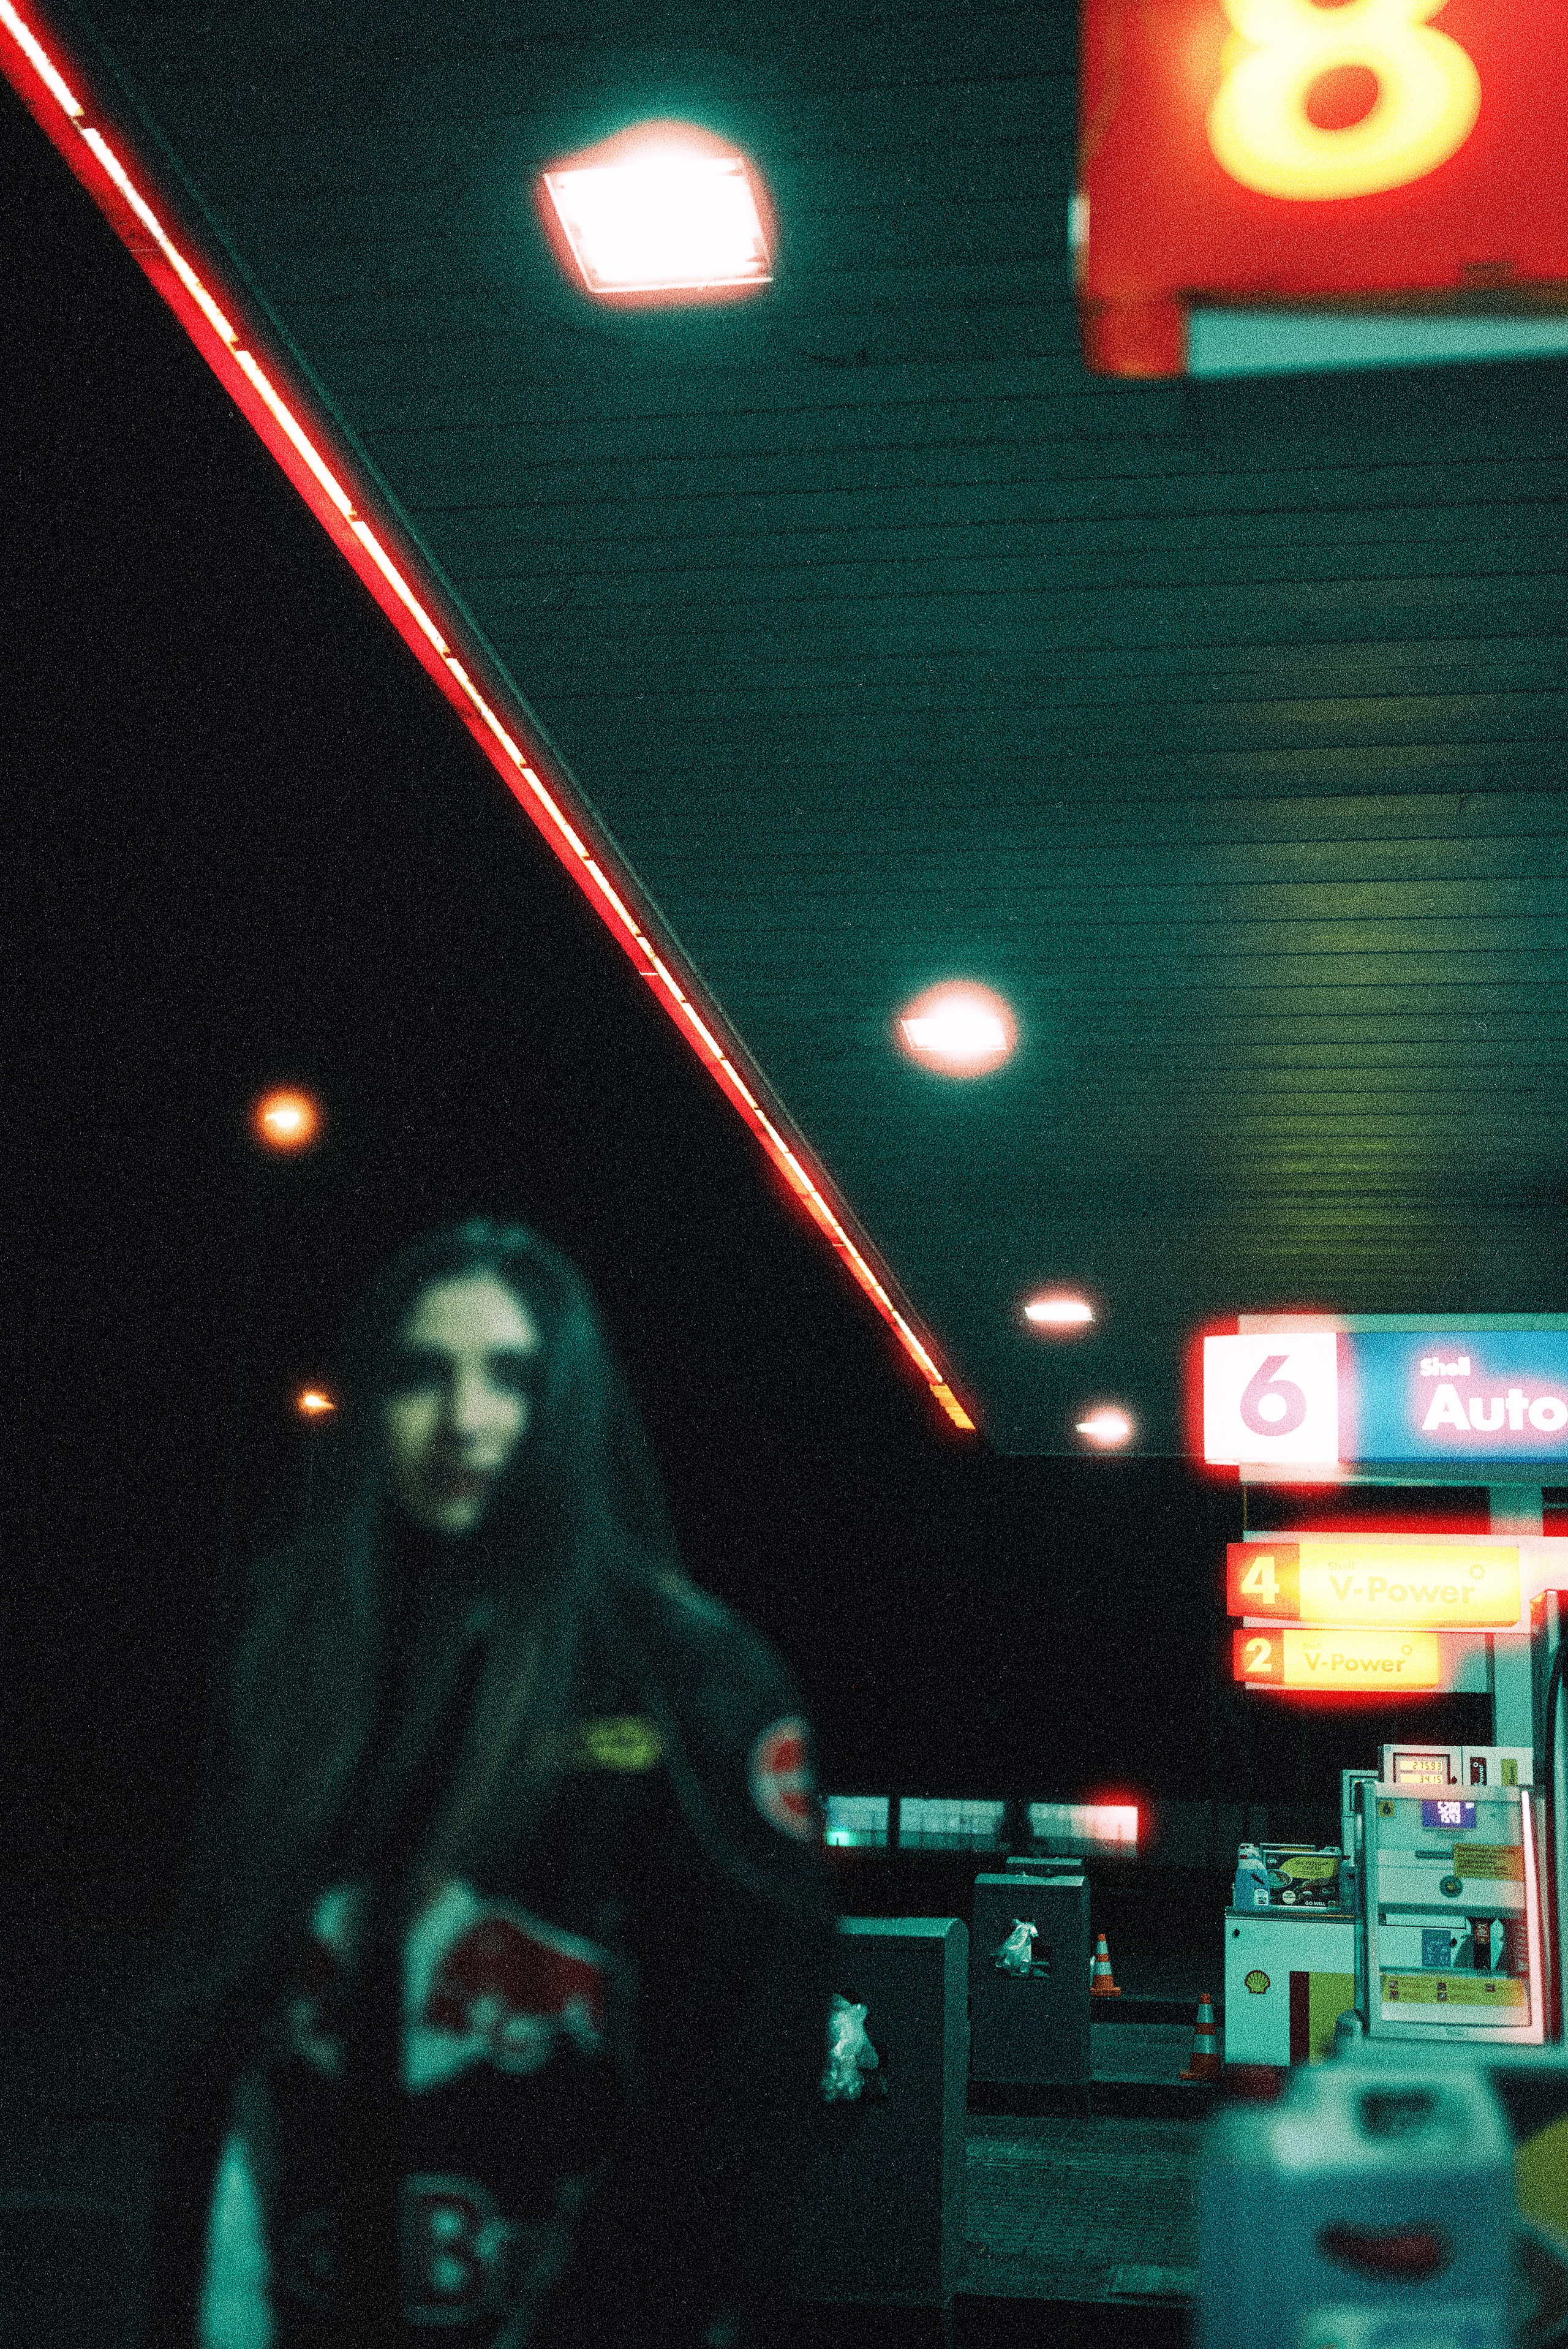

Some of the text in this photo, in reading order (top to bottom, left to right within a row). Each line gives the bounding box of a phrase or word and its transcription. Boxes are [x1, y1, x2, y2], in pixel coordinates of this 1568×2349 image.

[1205, 0, 1483, 201] 8
[1420, 1357, 1470, 1376] Shell
[1240, 1355, 1306, 1436] 6
[1422, 1384, 1568, 1431] Auto
[1241, 1556, 1279, 1604] 4
[1328, 1561, 1355, 1571] Shell
[1329, 1576, 1476, 1604] V-Power
[1246, 1638, 1272, 1672] 2
[1305, 1653, 1405, 1672] V-Power
